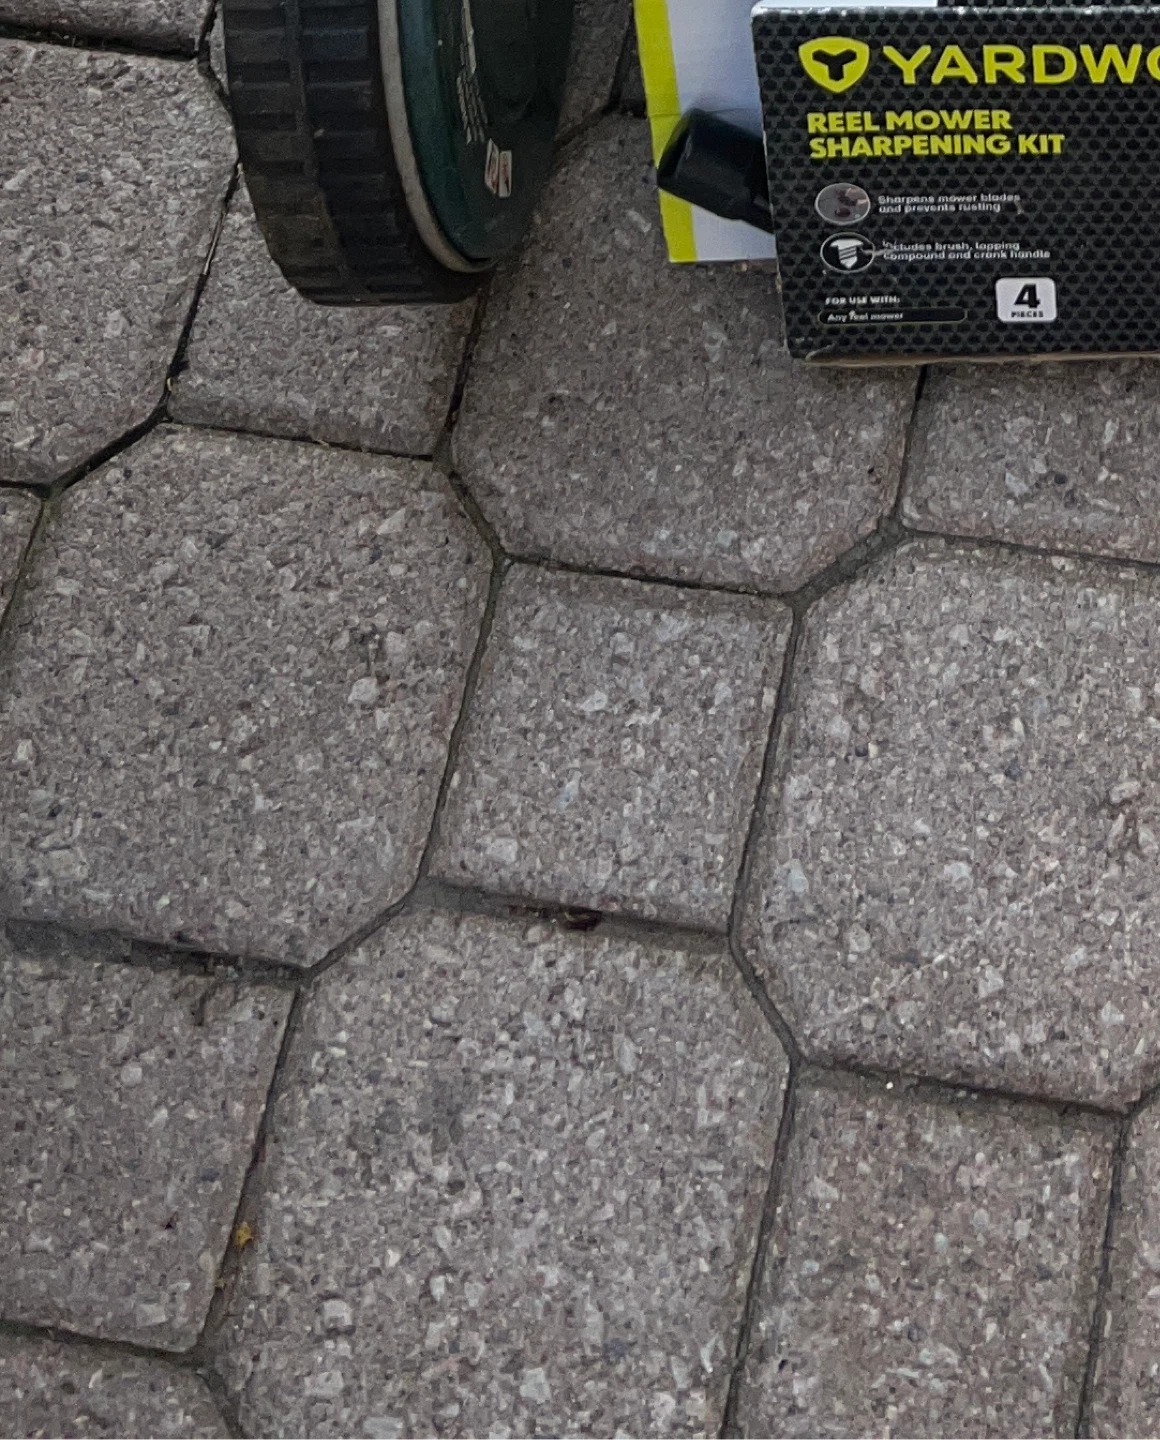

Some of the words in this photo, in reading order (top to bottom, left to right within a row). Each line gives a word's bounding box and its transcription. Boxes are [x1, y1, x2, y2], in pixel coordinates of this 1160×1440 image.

[807, 110, 881, 134] REEL
[886, 109, 1012, 132] MOWER
[809, 134, 1011, 160] SHARPENING
[1018, 133, 1065, 155] KIT
[877, 195, 935, 205] Sharpens
[937, 195, 977, 203] mower
[980, 193, 1021, 203] blades
[878, 204, 902, 214] and
[904, 204, 956, 214] prevents
[958, 202, 1002, 213] rusting
[935, 241, 973, 252] brush,
[975, 241, 1020, 252] lapping
[947, 250, 971, 260] and
[973, 250, 1008, 260] crank
[1009, 249, 1051, 259] handle
[825, 297, 847, 306] FOR
[1013, 283, 1042, 309] 4
[826, 313, 847, 323] Any
[869, 312, 904, 320] mower
[1010, 310, 1044, 319] PIECES
